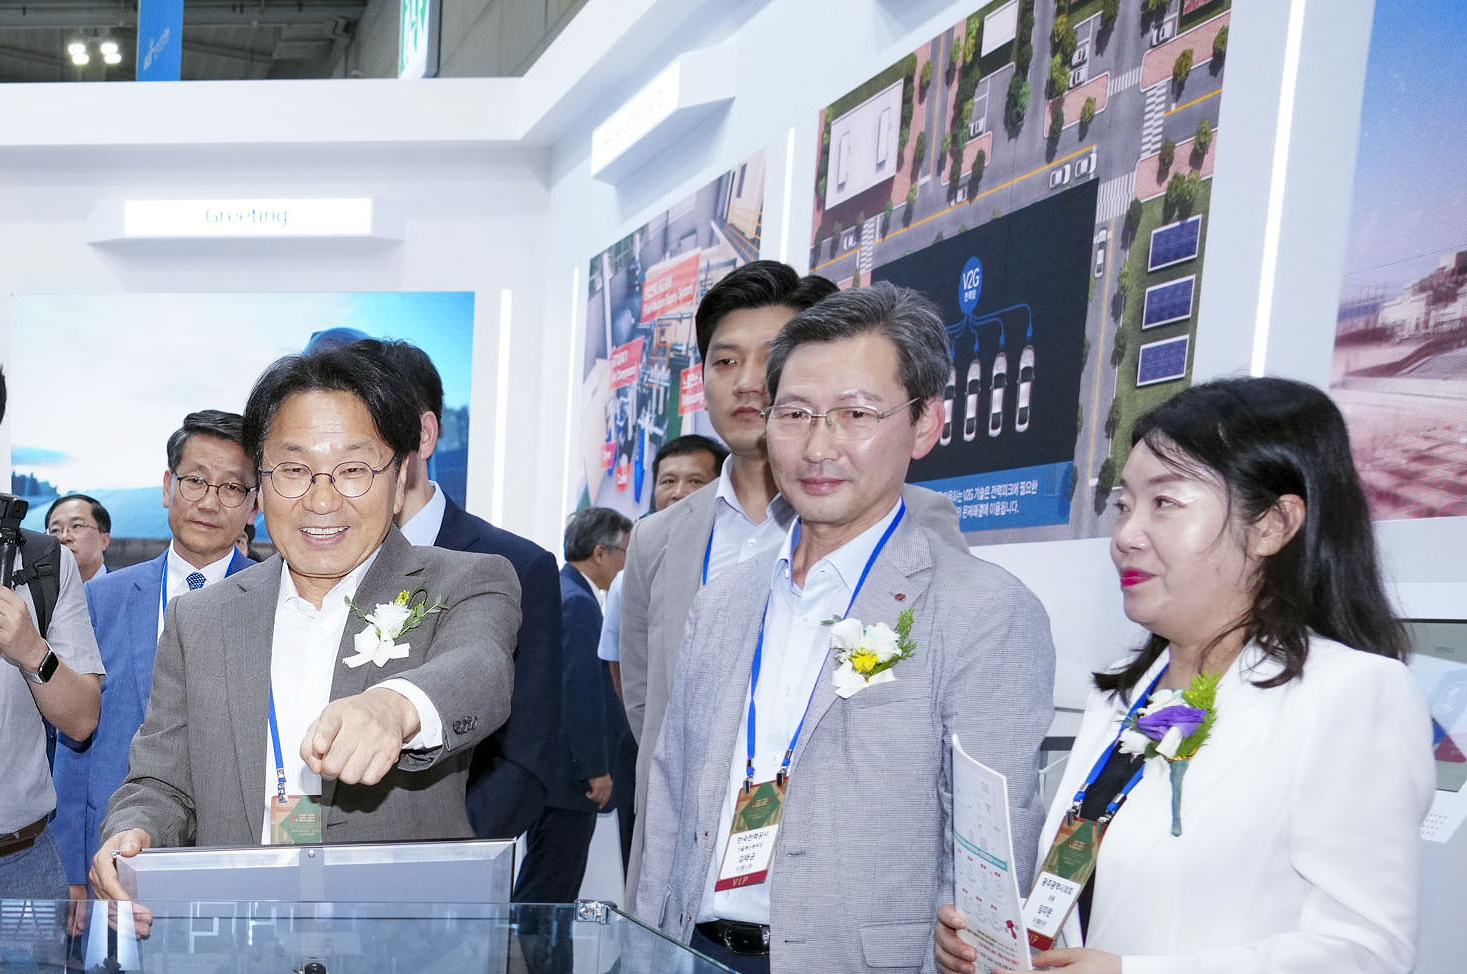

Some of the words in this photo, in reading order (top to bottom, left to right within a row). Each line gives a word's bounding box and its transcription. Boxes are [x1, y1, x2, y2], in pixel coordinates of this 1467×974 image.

[205, 207, 288, 228] Greeting
[962, 266, 980, 290] V2G
[732, 876, 749, 887] VIP
